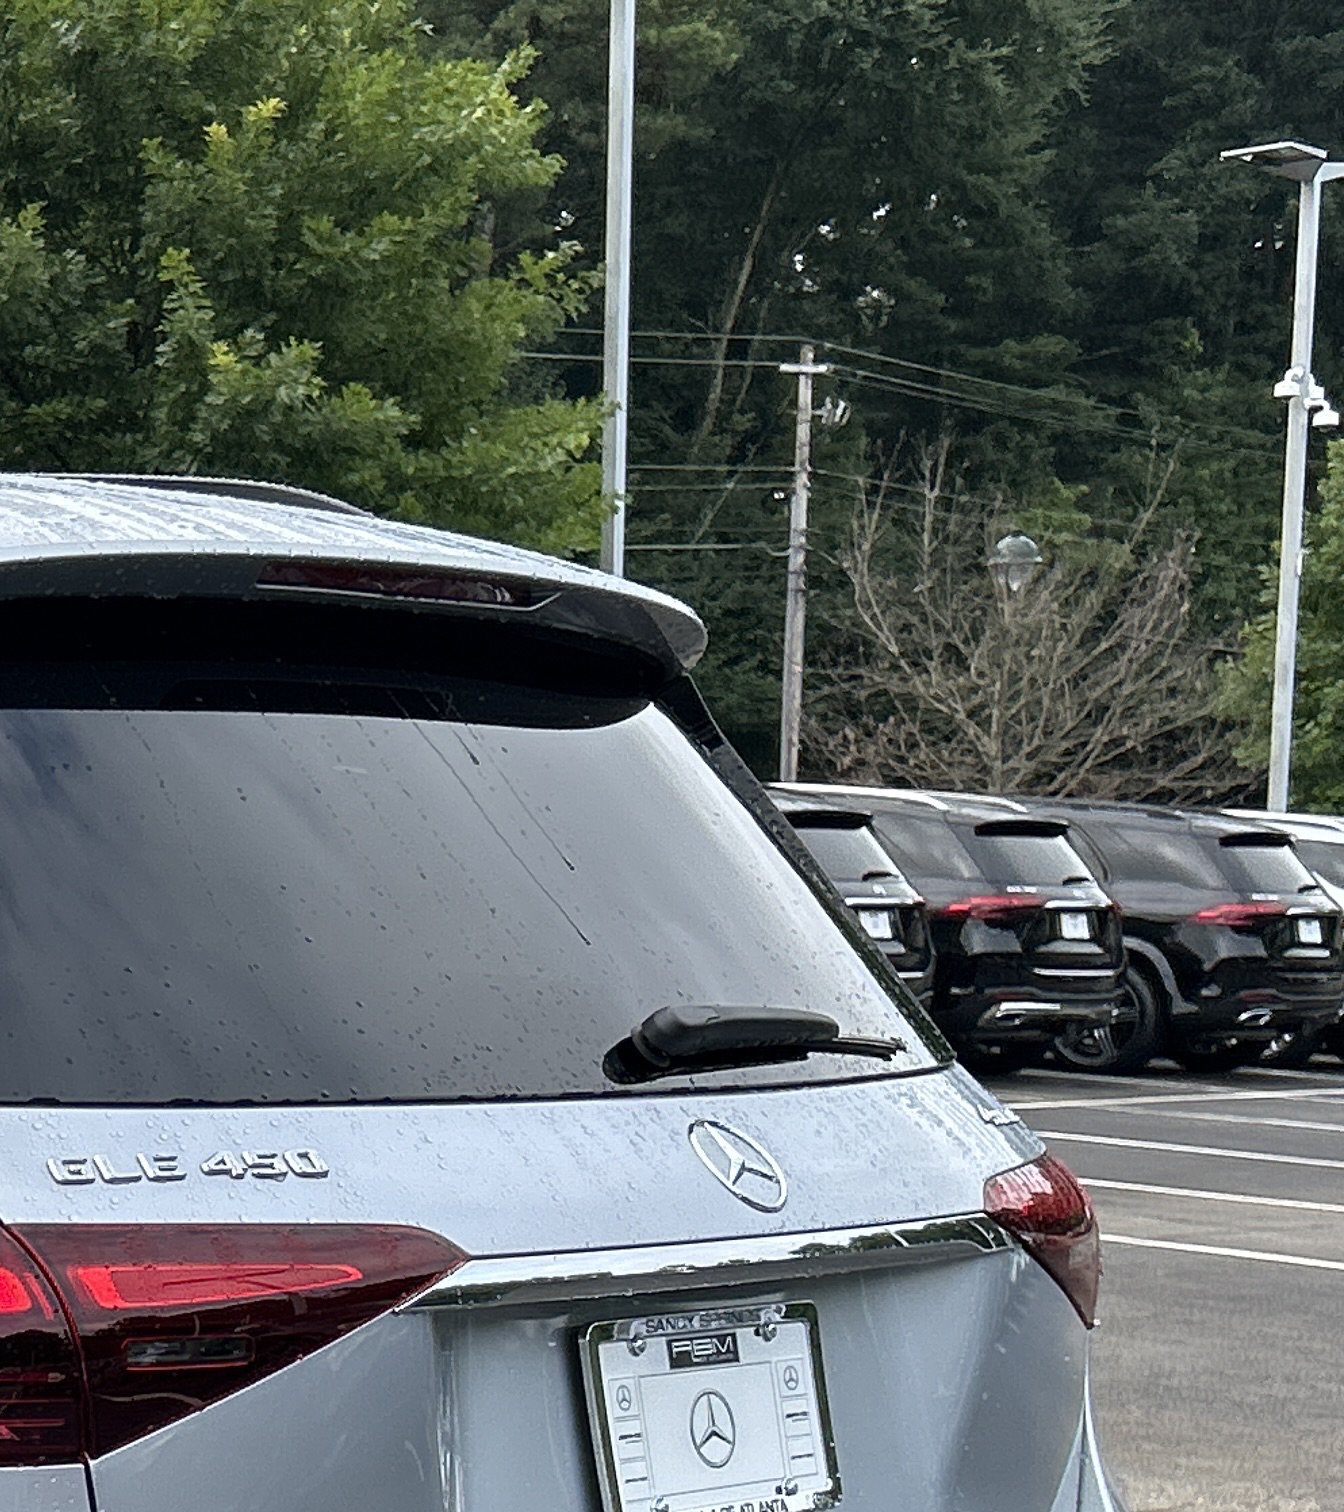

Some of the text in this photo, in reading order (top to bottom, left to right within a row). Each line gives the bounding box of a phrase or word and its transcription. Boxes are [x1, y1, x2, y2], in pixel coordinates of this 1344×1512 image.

[46, 1150, 330, 1185] GLE 450
[645, 1315, 696, 1334] SANDY
